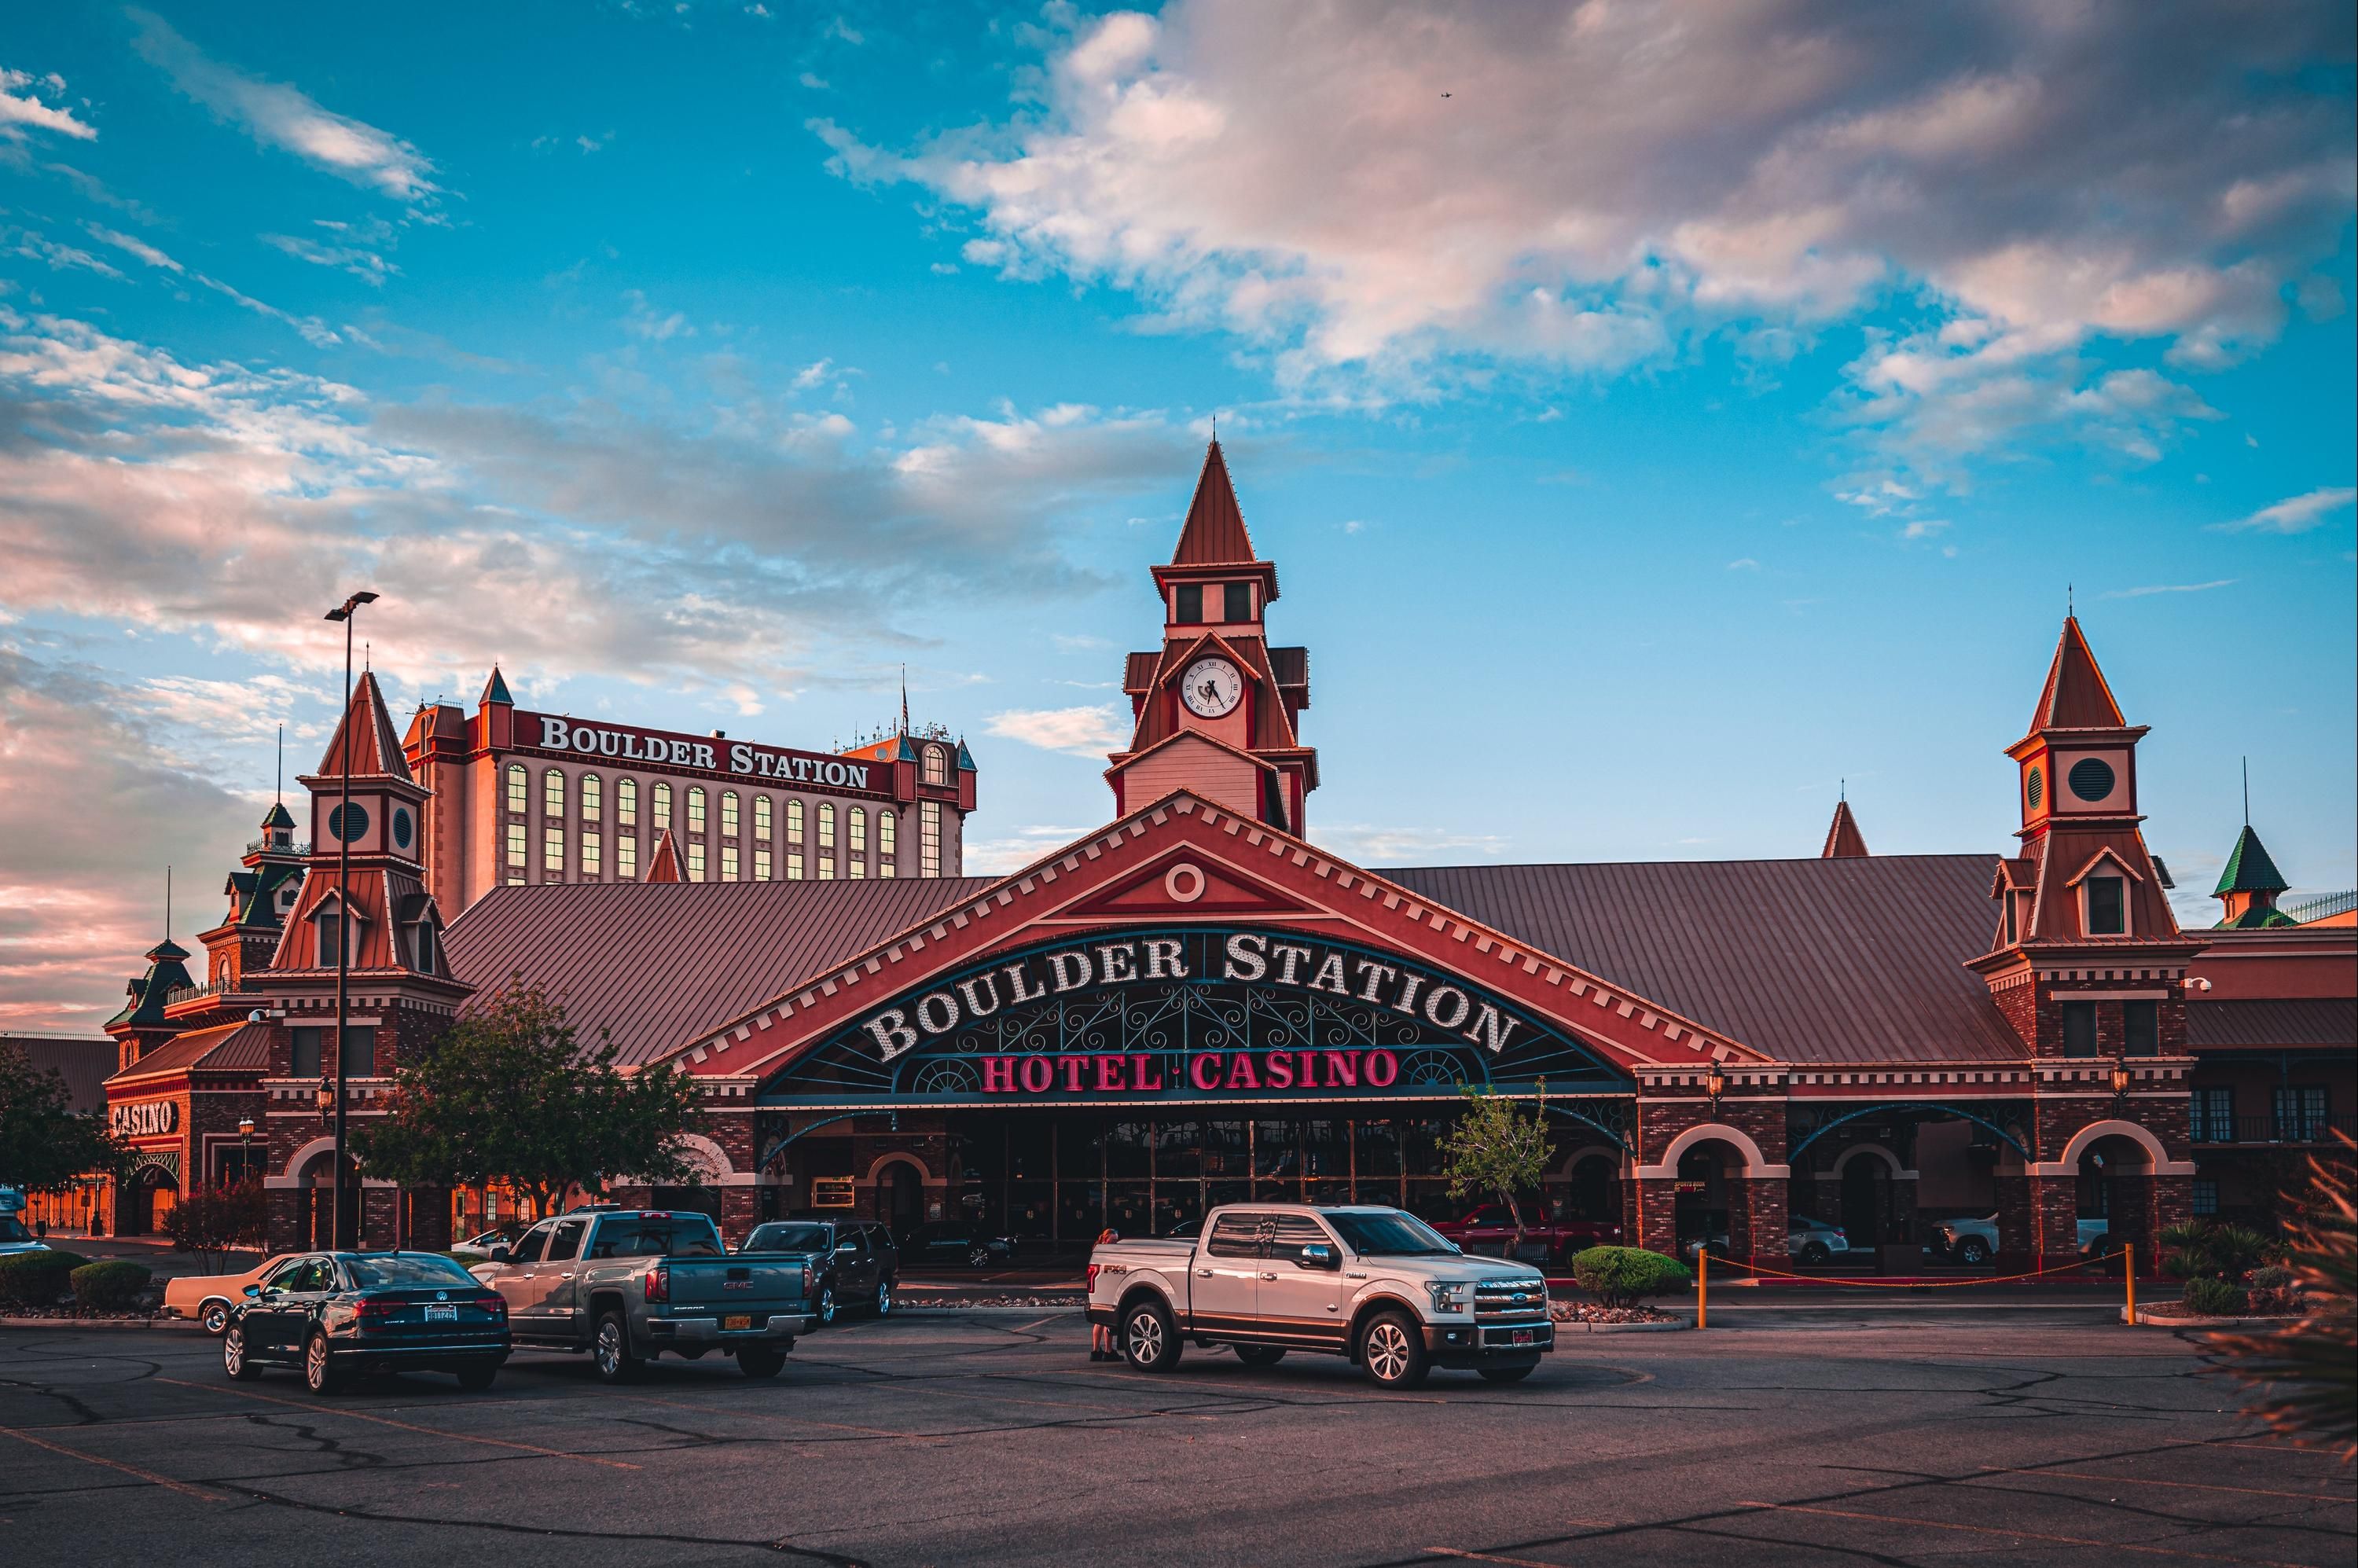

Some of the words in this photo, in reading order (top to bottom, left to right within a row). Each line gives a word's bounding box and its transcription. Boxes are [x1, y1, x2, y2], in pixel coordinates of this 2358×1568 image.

[540, 716, 716, 769] BOULDER
[731, 744, 869, 788] STATION
[862, 938, 1190, 1063] BOULDER
[1224, 934, 1522, 1054] STATION
[980, 1052, 1163, 1093] HOTEL
[1191, 1048, 1399, 1091] CASINO
[112, 1100, 172, 1137] CASINO
